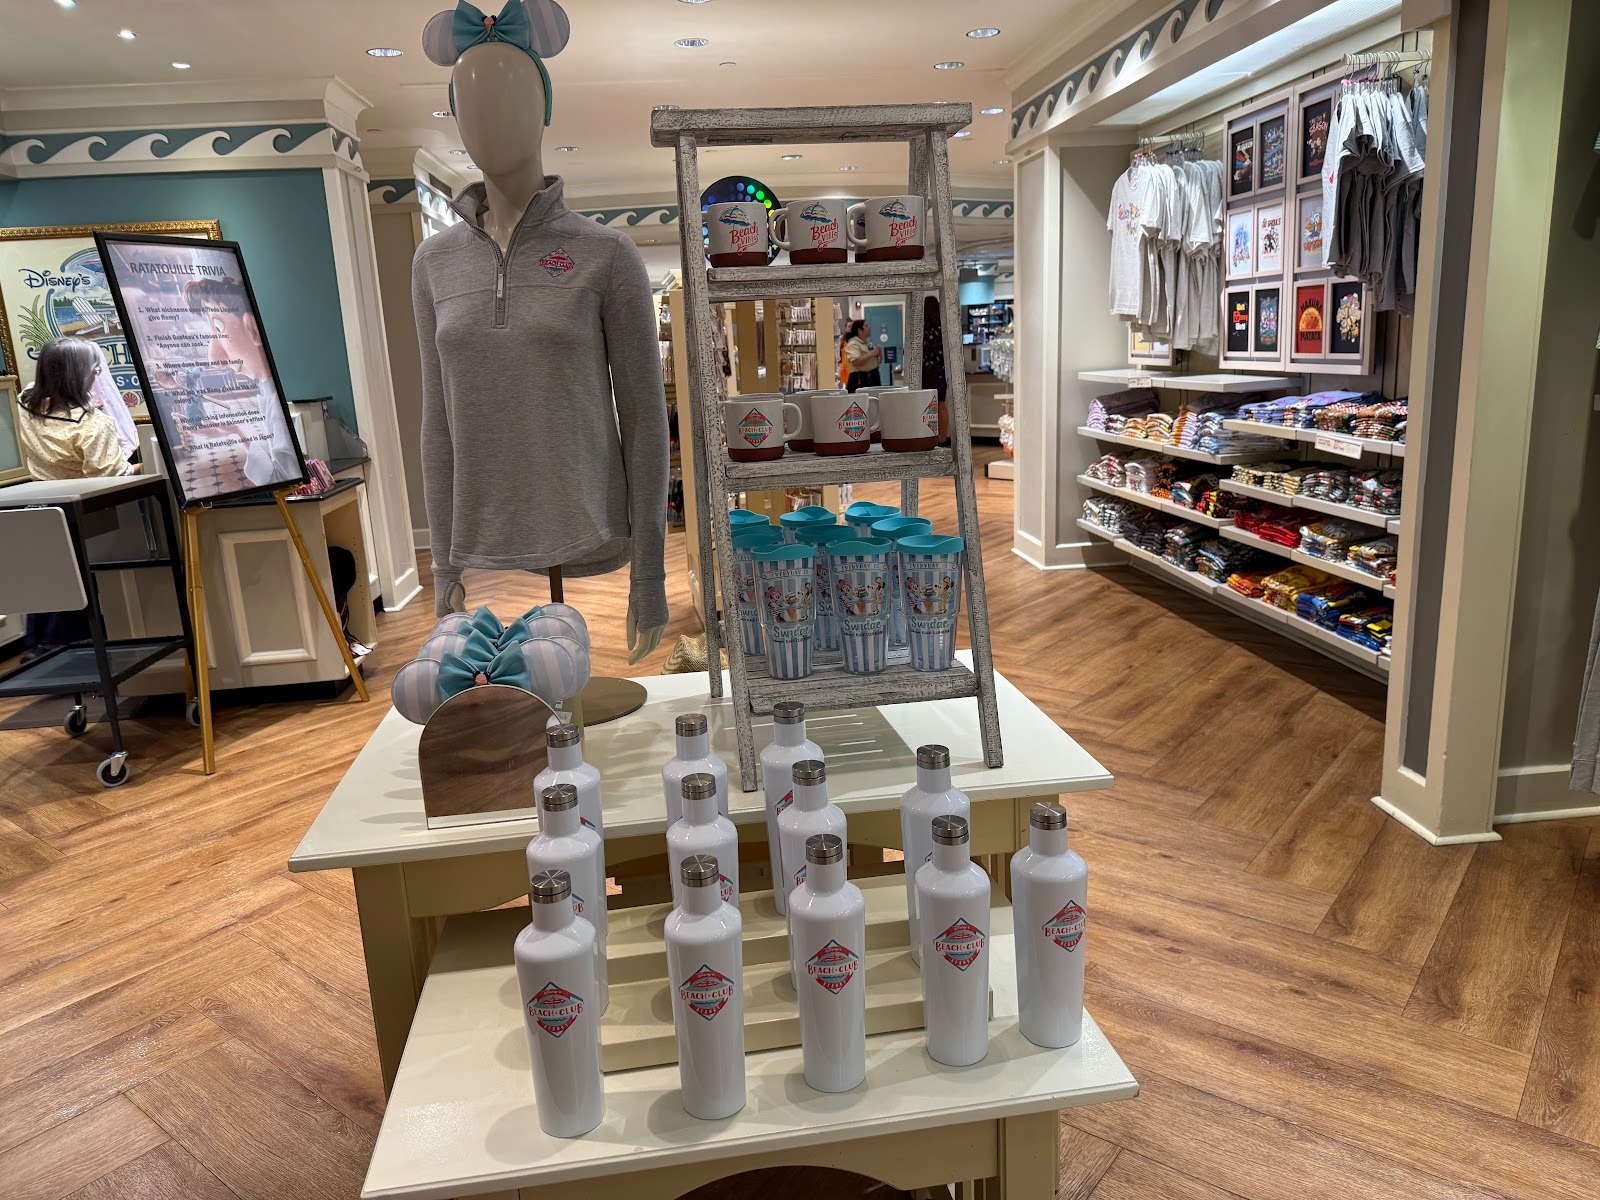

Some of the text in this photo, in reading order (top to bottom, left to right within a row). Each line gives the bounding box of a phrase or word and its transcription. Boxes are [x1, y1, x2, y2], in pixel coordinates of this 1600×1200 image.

[729, 221, 759, 244] Beach
[810, 217, 839, 241] Beach
[889, 215, 917, 237] Beach
[129, 262, 227, 277] RATATOUILLE TRIVIA
[844, 619, 881, 631] Sundae
[1044, 927, 1071, 937] BEACH
[935, 938, 985, 952] BEACH CLUB
[807, 960, 859, 975] BEACH CLUB
[680, 985, 734, 1000] BEACH CLUB
[528, 1002, 584, 1017] BEACH CLUB
